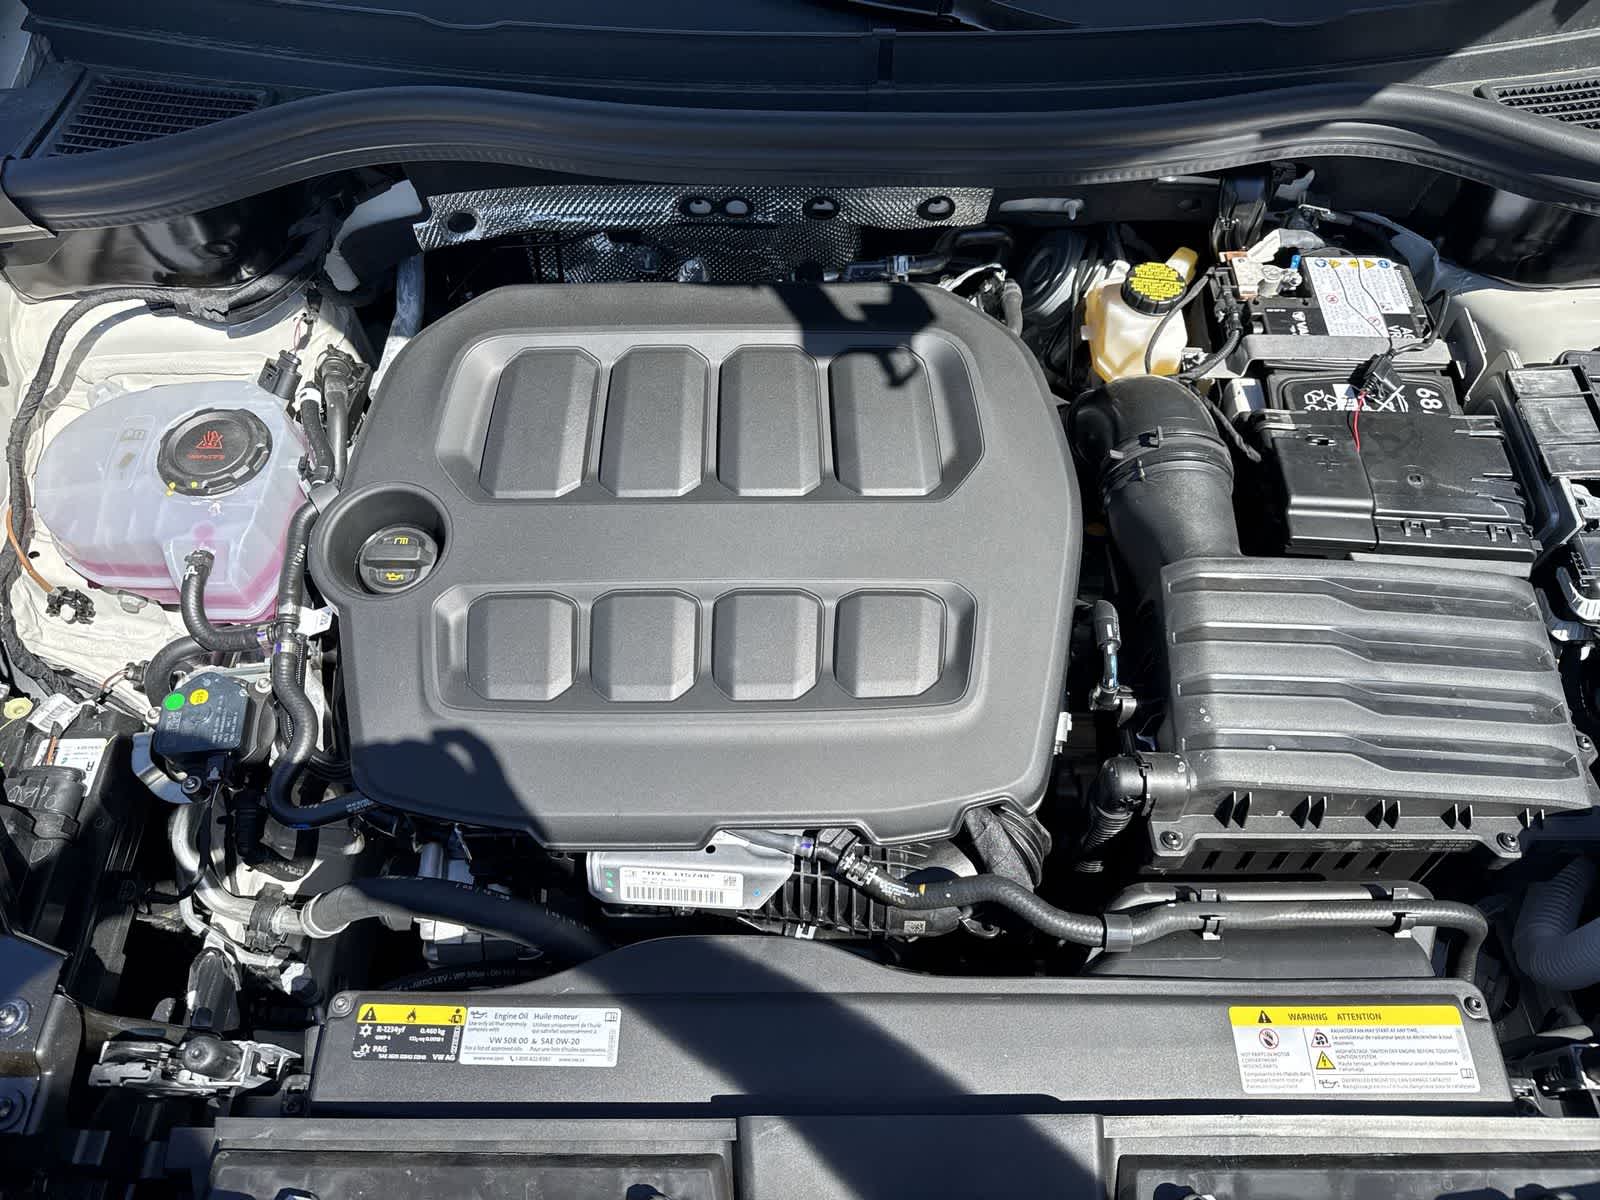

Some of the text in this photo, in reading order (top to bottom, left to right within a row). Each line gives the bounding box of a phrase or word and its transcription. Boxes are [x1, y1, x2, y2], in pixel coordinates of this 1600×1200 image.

[494, 1012, 529, 1021] Engine Oil
[534, 1012, 552, 1020] Huile
[1287, 1012, 1382, 1021] WARNING ATTENTION
